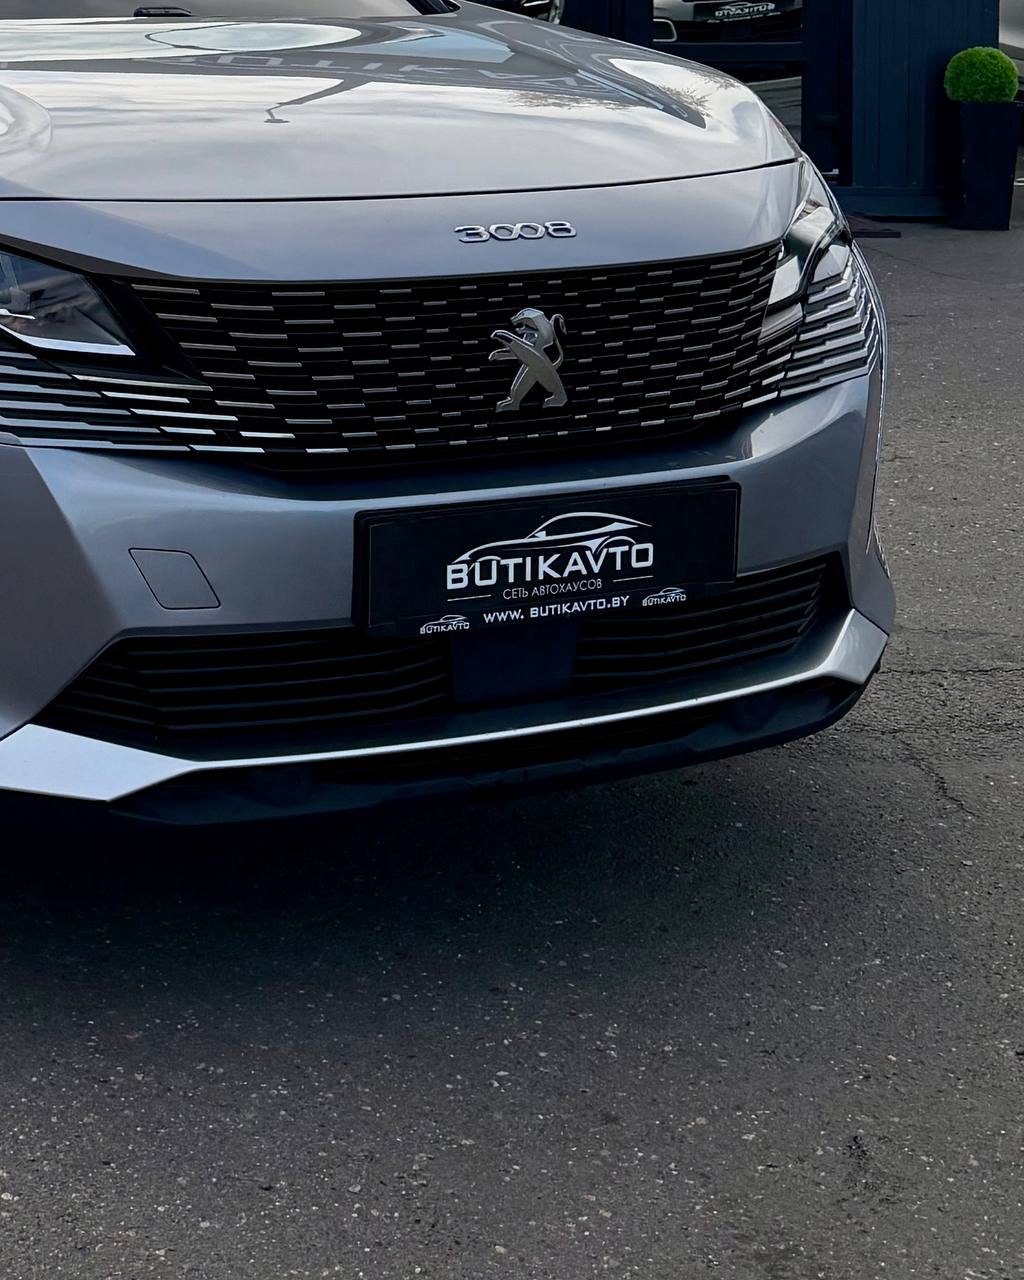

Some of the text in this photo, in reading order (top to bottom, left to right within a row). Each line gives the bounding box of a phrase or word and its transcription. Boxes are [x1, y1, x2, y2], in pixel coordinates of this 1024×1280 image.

[454, 221, 577, 244] 3008
[446, 542, 654, 590] BUTIKAVTO
[502, 578, 603, 600] СЕТЬ АВТОХАУСОВ
[641, 593, 687, 607] BUTIKAVTO
[483, 595, 630, 624] WWW. BUTIKAVTO.BY
[419, 621, 470, 635] BUTIKAVTO
